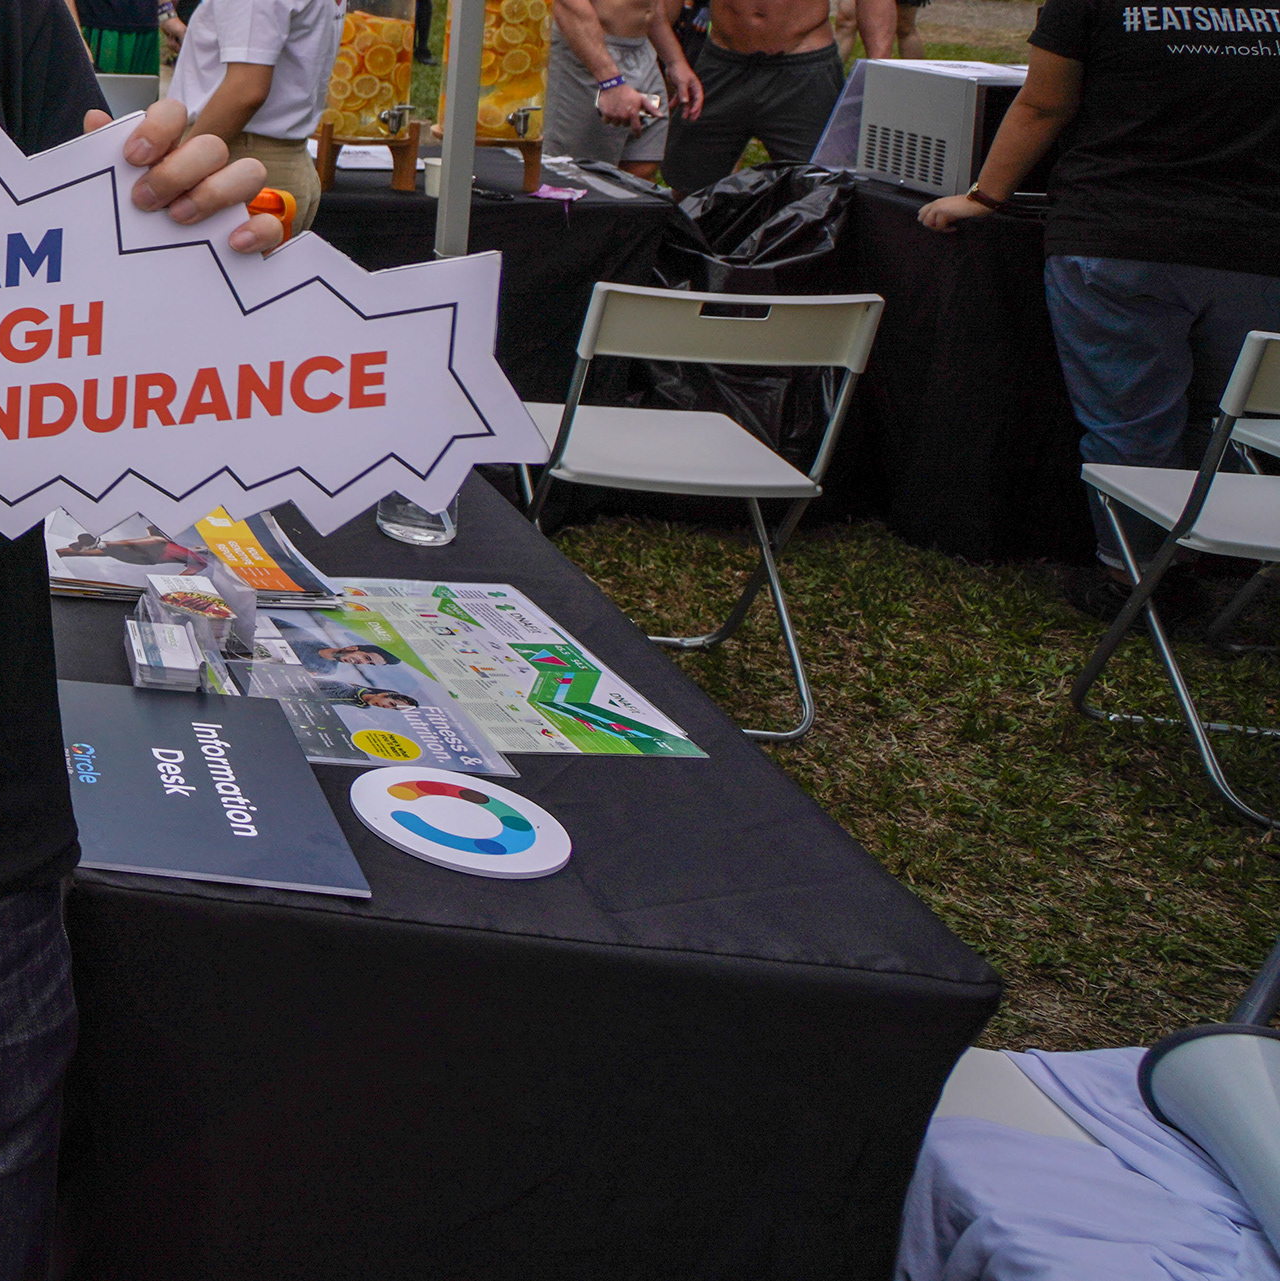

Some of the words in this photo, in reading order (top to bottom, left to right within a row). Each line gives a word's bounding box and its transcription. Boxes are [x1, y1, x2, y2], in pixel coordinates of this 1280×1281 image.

[1122, 6, 1280, 33] #EATSMART
[394, 704, 452, 764] Nutrition.
[420, 705, 468, 753] Fitness
[460, 755, 483, 767] &
[71, 742, 102, 784] Circle
[151, 747, 197, 798] Desk
[191, 721, 259, 838] Information
